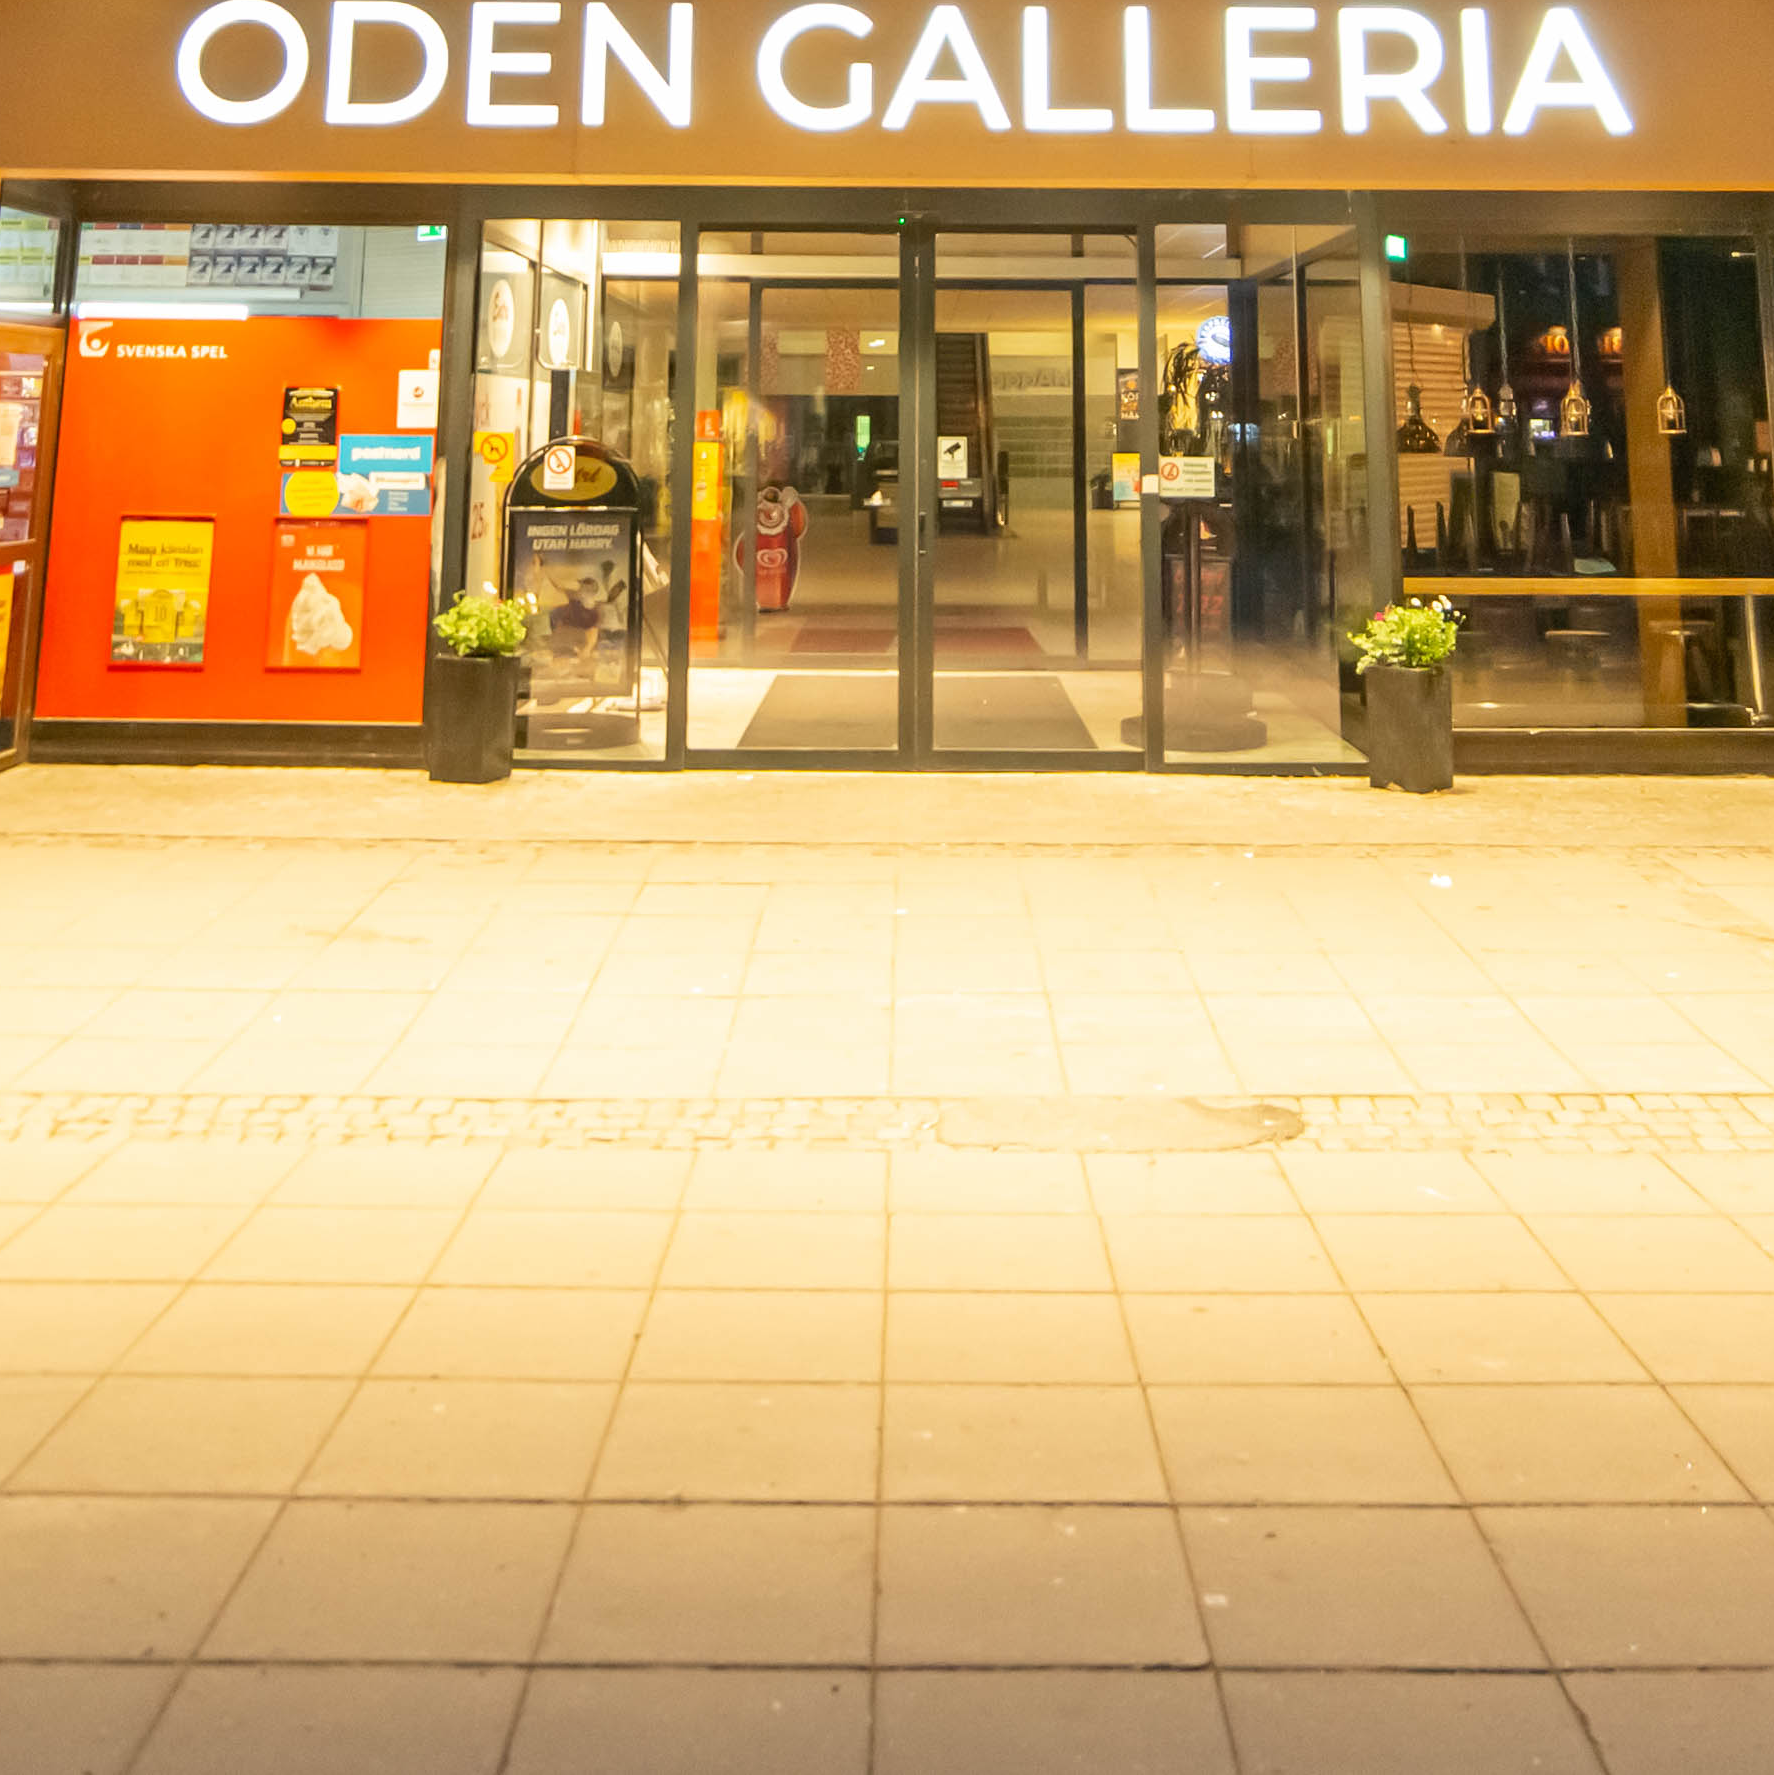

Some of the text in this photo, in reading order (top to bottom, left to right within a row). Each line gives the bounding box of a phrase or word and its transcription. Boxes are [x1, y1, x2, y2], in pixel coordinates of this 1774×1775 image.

[756, 3, 1636, 136] GALLERIA
[116, 344, 228, 359] SVENSKA SPEL
[527, 523, 620, 537] INGEN LÖRDAG
[532, 538, 567, 550] UTAN
